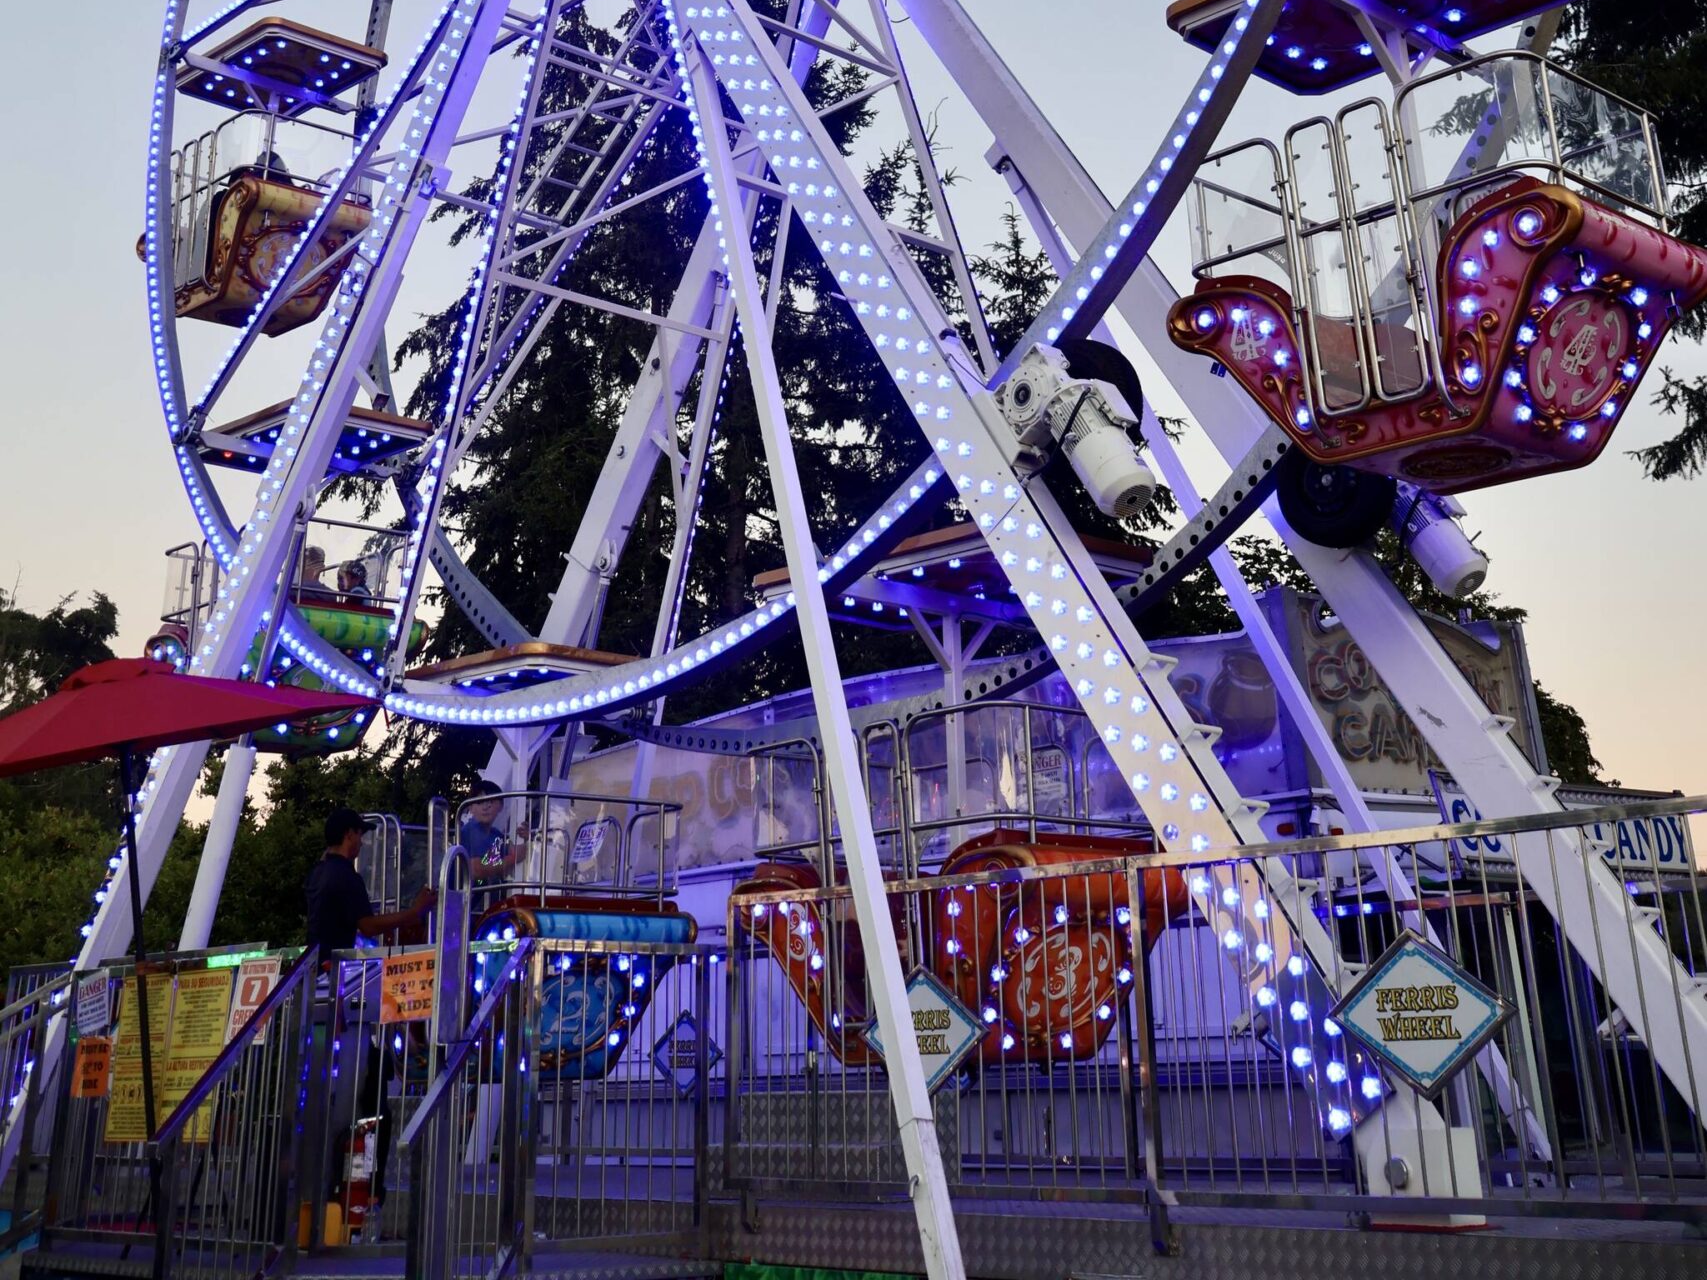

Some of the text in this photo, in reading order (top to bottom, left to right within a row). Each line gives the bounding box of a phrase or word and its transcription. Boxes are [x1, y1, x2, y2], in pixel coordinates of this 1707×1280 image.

[1230, 309, 1268, 362] 4
[1560, 324, 1599, 376] 4
[386, 959, 435, 977] MUST B
[1042, 946, 1083, 1001] 3
[79, 976, 107, 1000] DANGER
[1375, 984, 1459, 1013] FERRIS
[396, 998, 431, 1014] RIDE
[551, 991, 591, 1034] 2
[911, 1008, 951, 1032] RRIS
[1377, 1012, 1461, 1041] WHEEL
[916, 1034, 951, 1055] EEL
